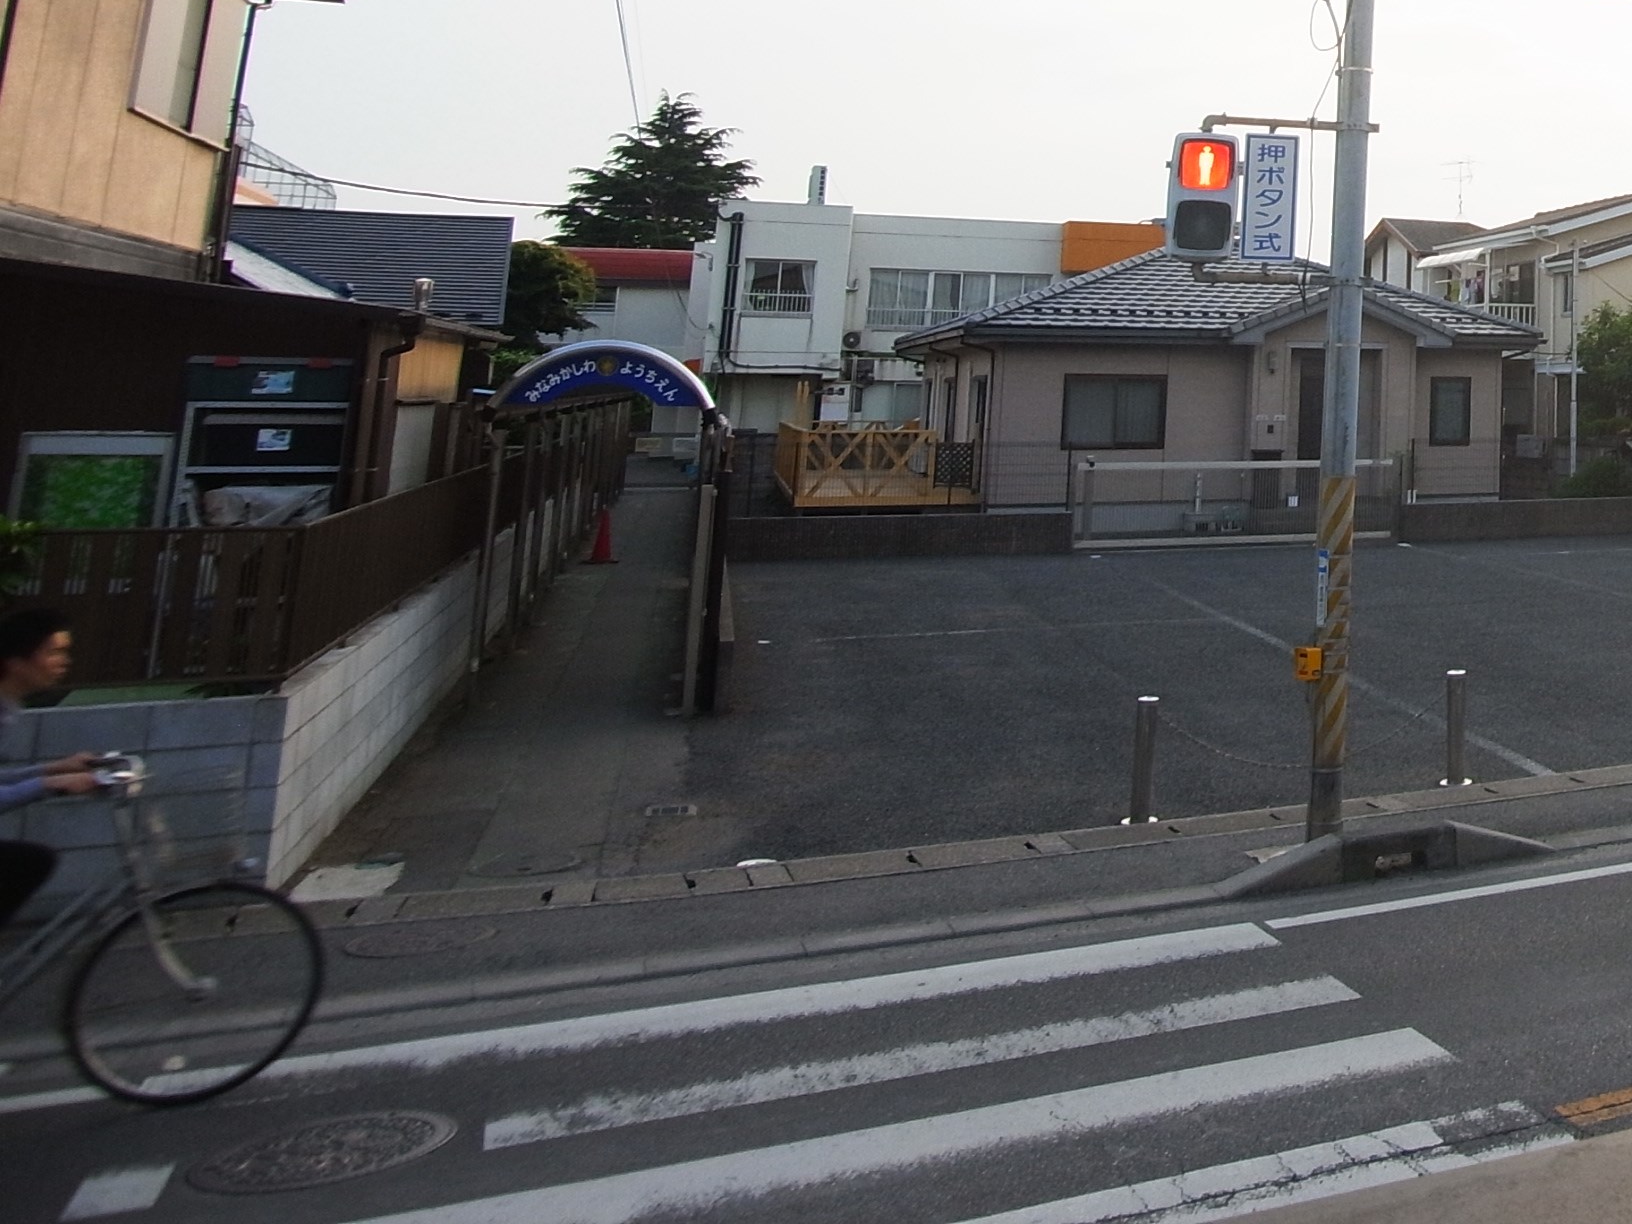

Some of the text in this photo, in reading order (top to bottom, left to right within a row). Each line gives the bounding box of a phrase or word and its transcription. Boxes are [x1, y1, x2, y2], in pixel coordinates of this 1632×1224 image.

[1253, 143, 1286, 252] 押ボタン式
[525, 359, 679, 403] みなみかしわ ようちえん
